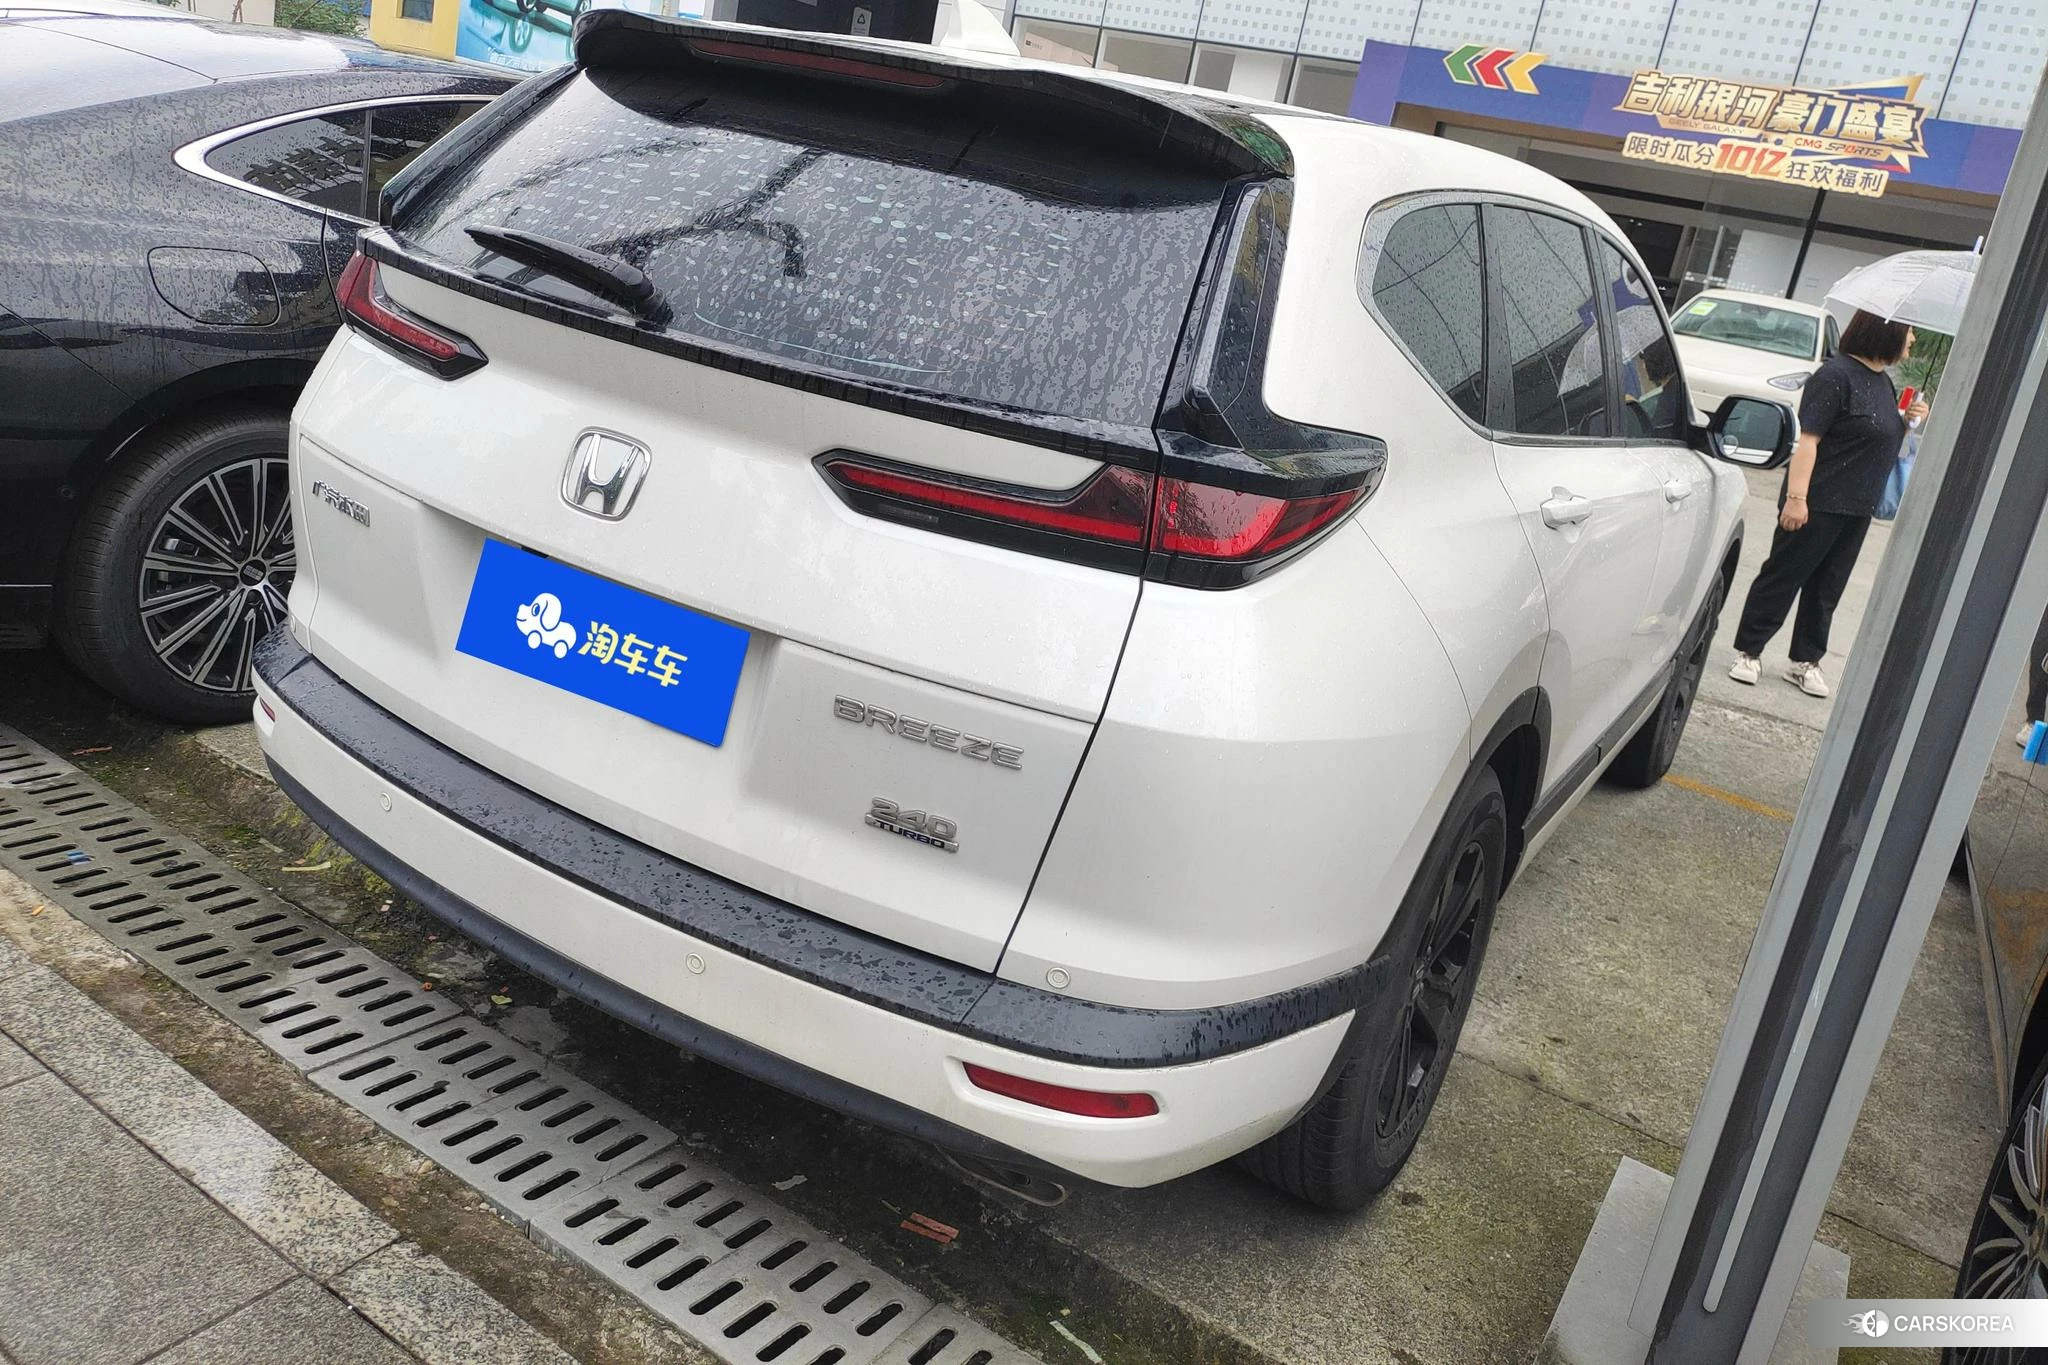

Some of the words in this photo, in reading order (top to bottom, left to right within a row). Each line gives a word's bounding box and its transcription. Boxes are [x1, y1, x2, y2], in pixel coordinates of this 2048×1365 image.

[1668, 117, 1700, 129] GEELY
[1703, 123, 1744, 135] GALAXY
[1628, 135, 1884, 193] 限时瓜分10亿狂欢福利
[1794, 137, 1823, 149] CMG
[1825, 142, 1882, 158] SPORTS
[833, 694, 1024, 770] BREEZE
[870, 796, 957, 839] 240
[874, 820, 945, 849] TURBO
